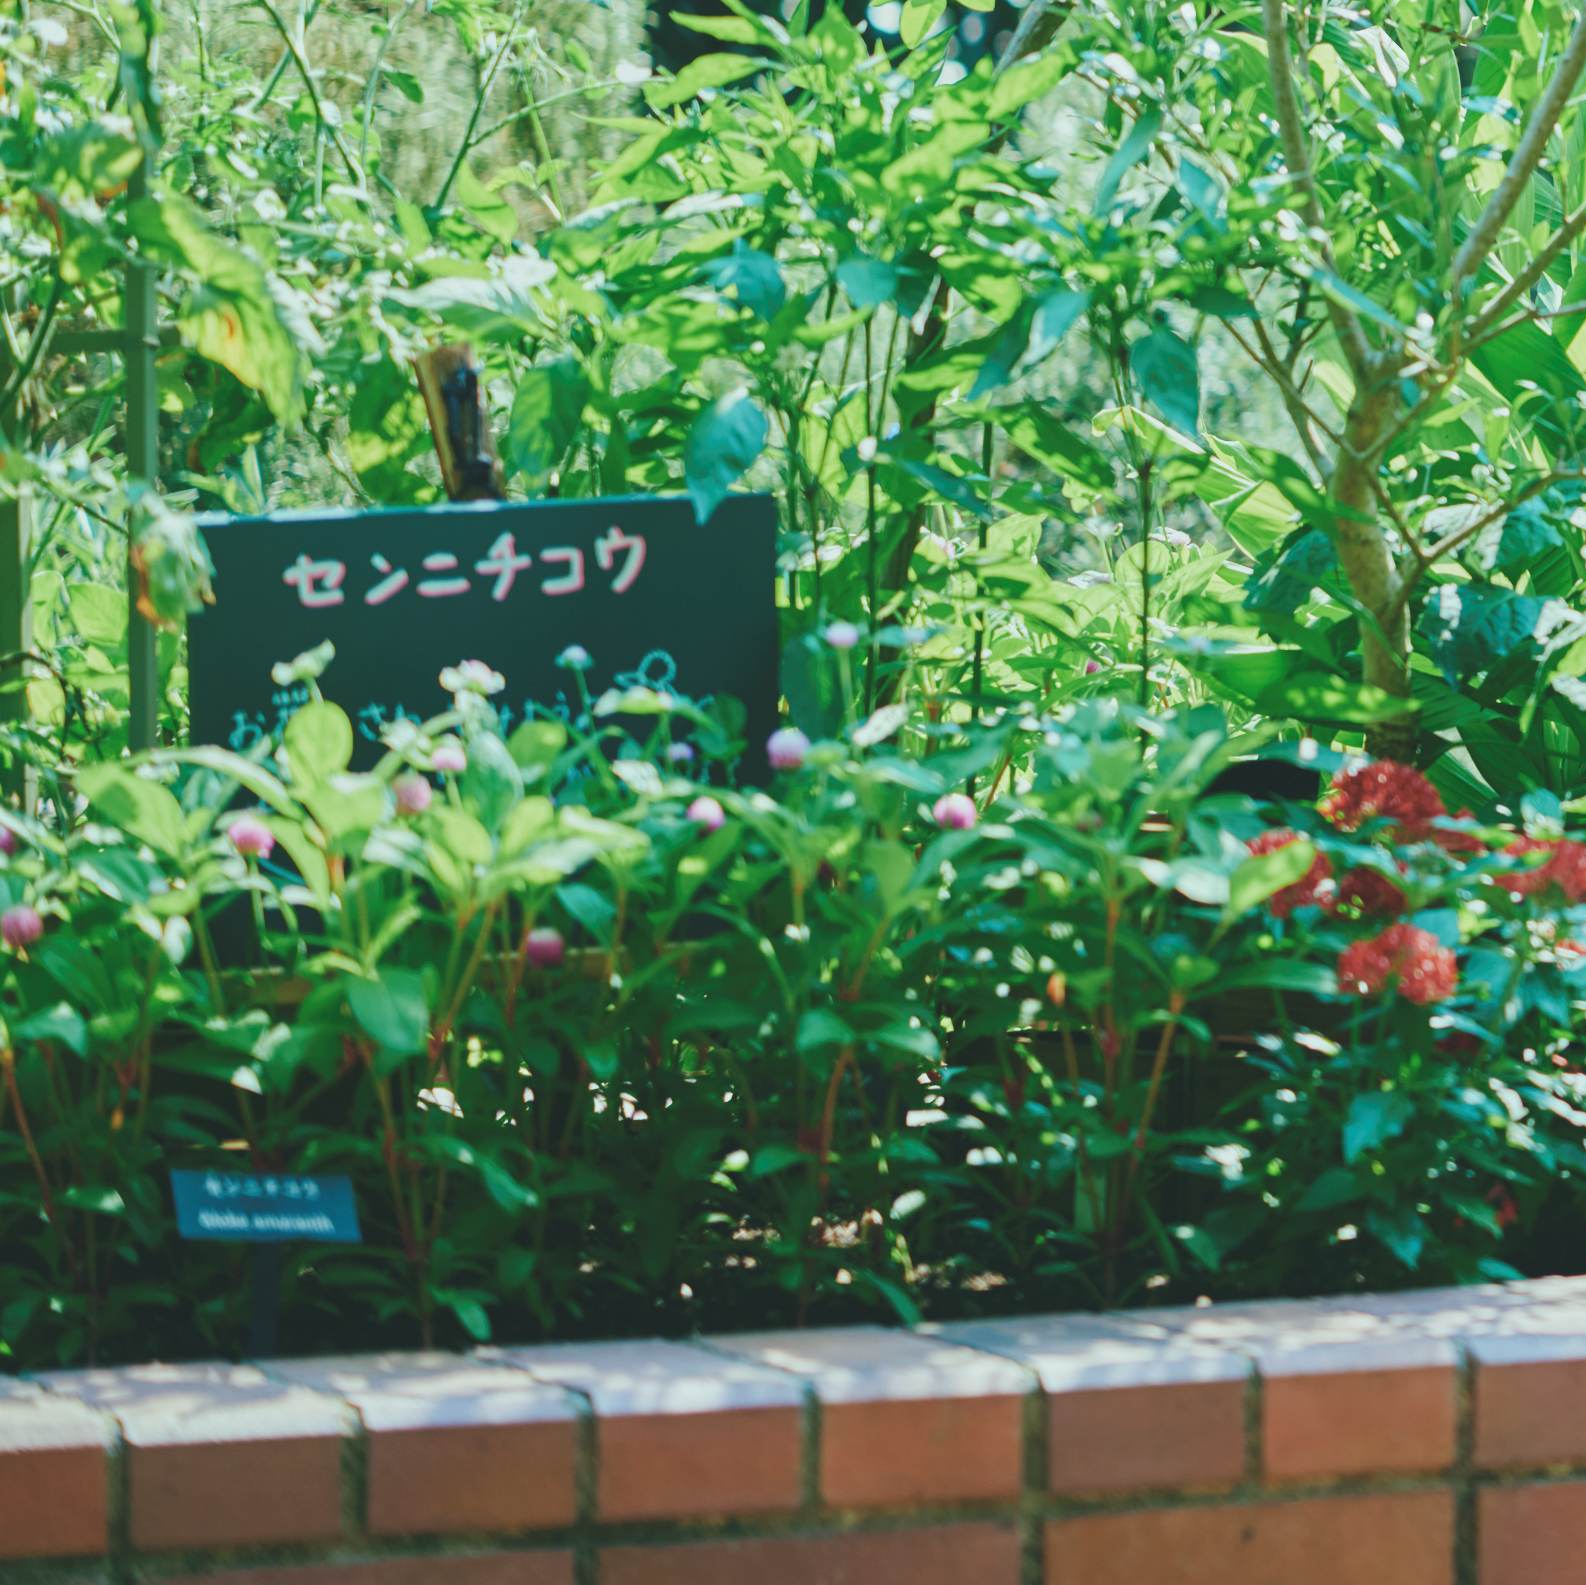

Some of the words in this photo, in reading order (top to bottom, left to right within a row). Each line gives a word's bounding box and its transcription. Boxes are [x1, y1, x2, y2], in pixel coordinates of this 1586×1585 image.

[282, 526, 647, 607] センニチコウ
